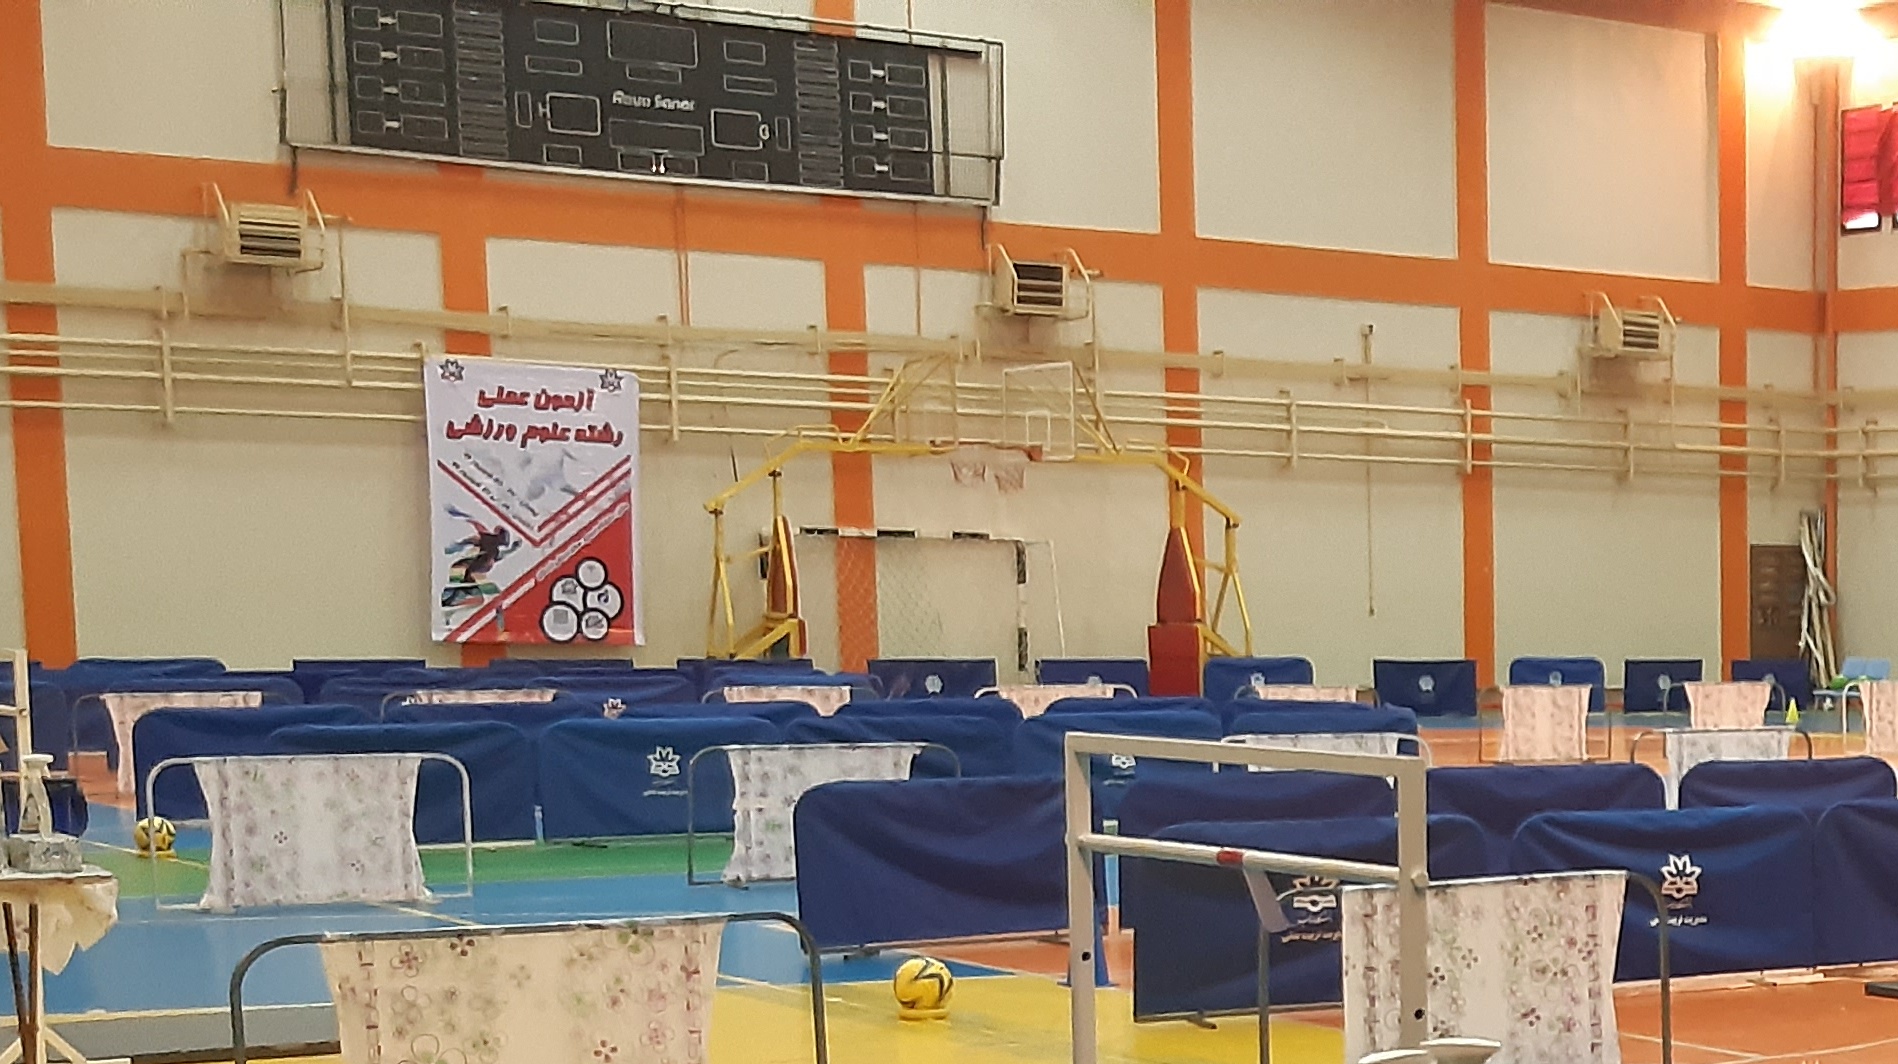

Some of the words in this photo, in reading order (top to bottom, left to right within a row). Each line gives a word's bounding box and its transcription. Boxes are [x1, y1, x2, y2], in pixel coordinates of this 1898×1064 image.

[477, 385, 531, 408] عملی
[533, 387, 595, 413] آزمون
[446, 413, 517, 440] ورزشی
[520, 421, 572, 448] علوم
[574, 421, 623, 447] رشته
